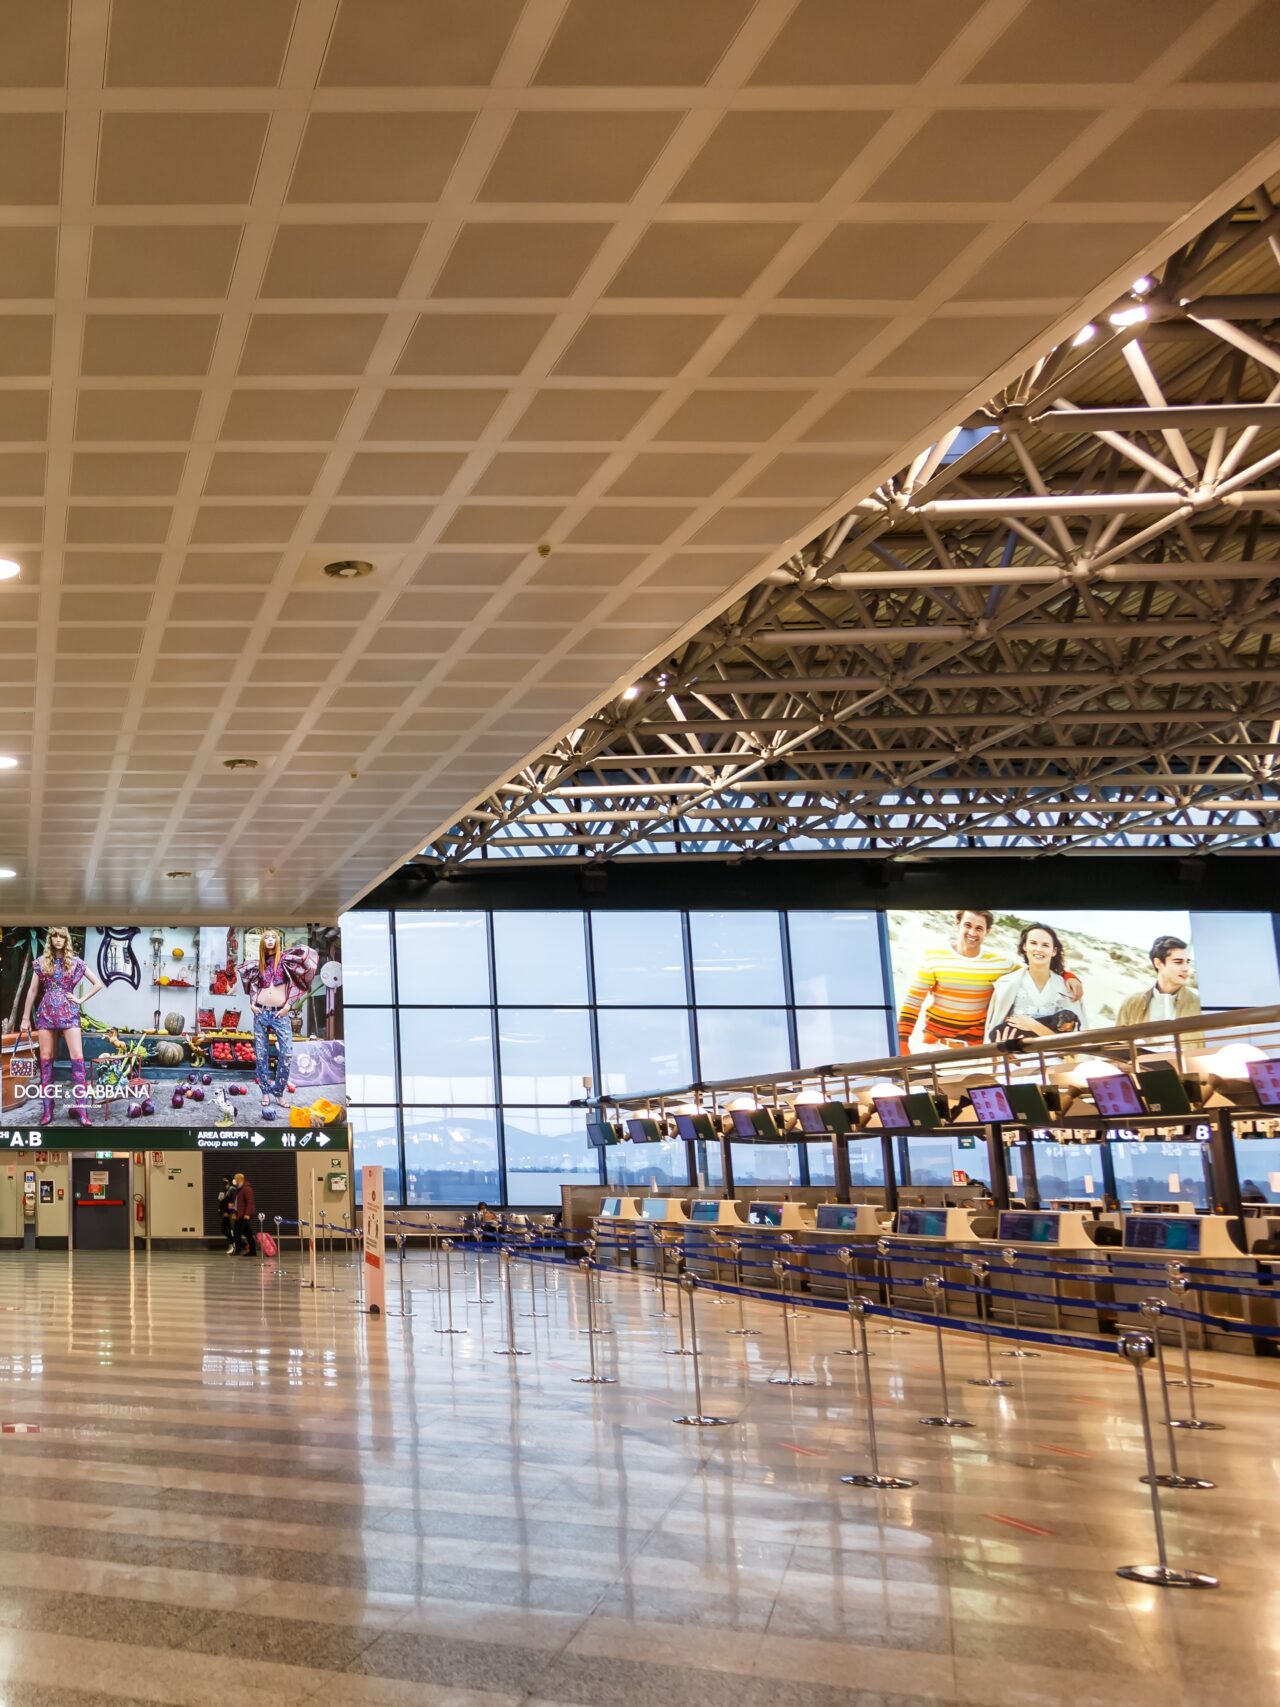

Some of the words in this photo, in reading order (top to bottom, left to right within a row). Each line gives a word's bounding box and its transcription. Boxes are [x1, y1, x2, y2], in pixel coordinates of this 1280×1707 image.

[14, 1084, 62, 1099] DOLCE
[64, 1091, 71, 1099] &
[72, 1084, 150, 1099] GABBANA
[197, 1131, 219, 1139] AREA
[220, 1131, 249, 1139] GRUPPI
[198, 1140, 220, 1148] Group
